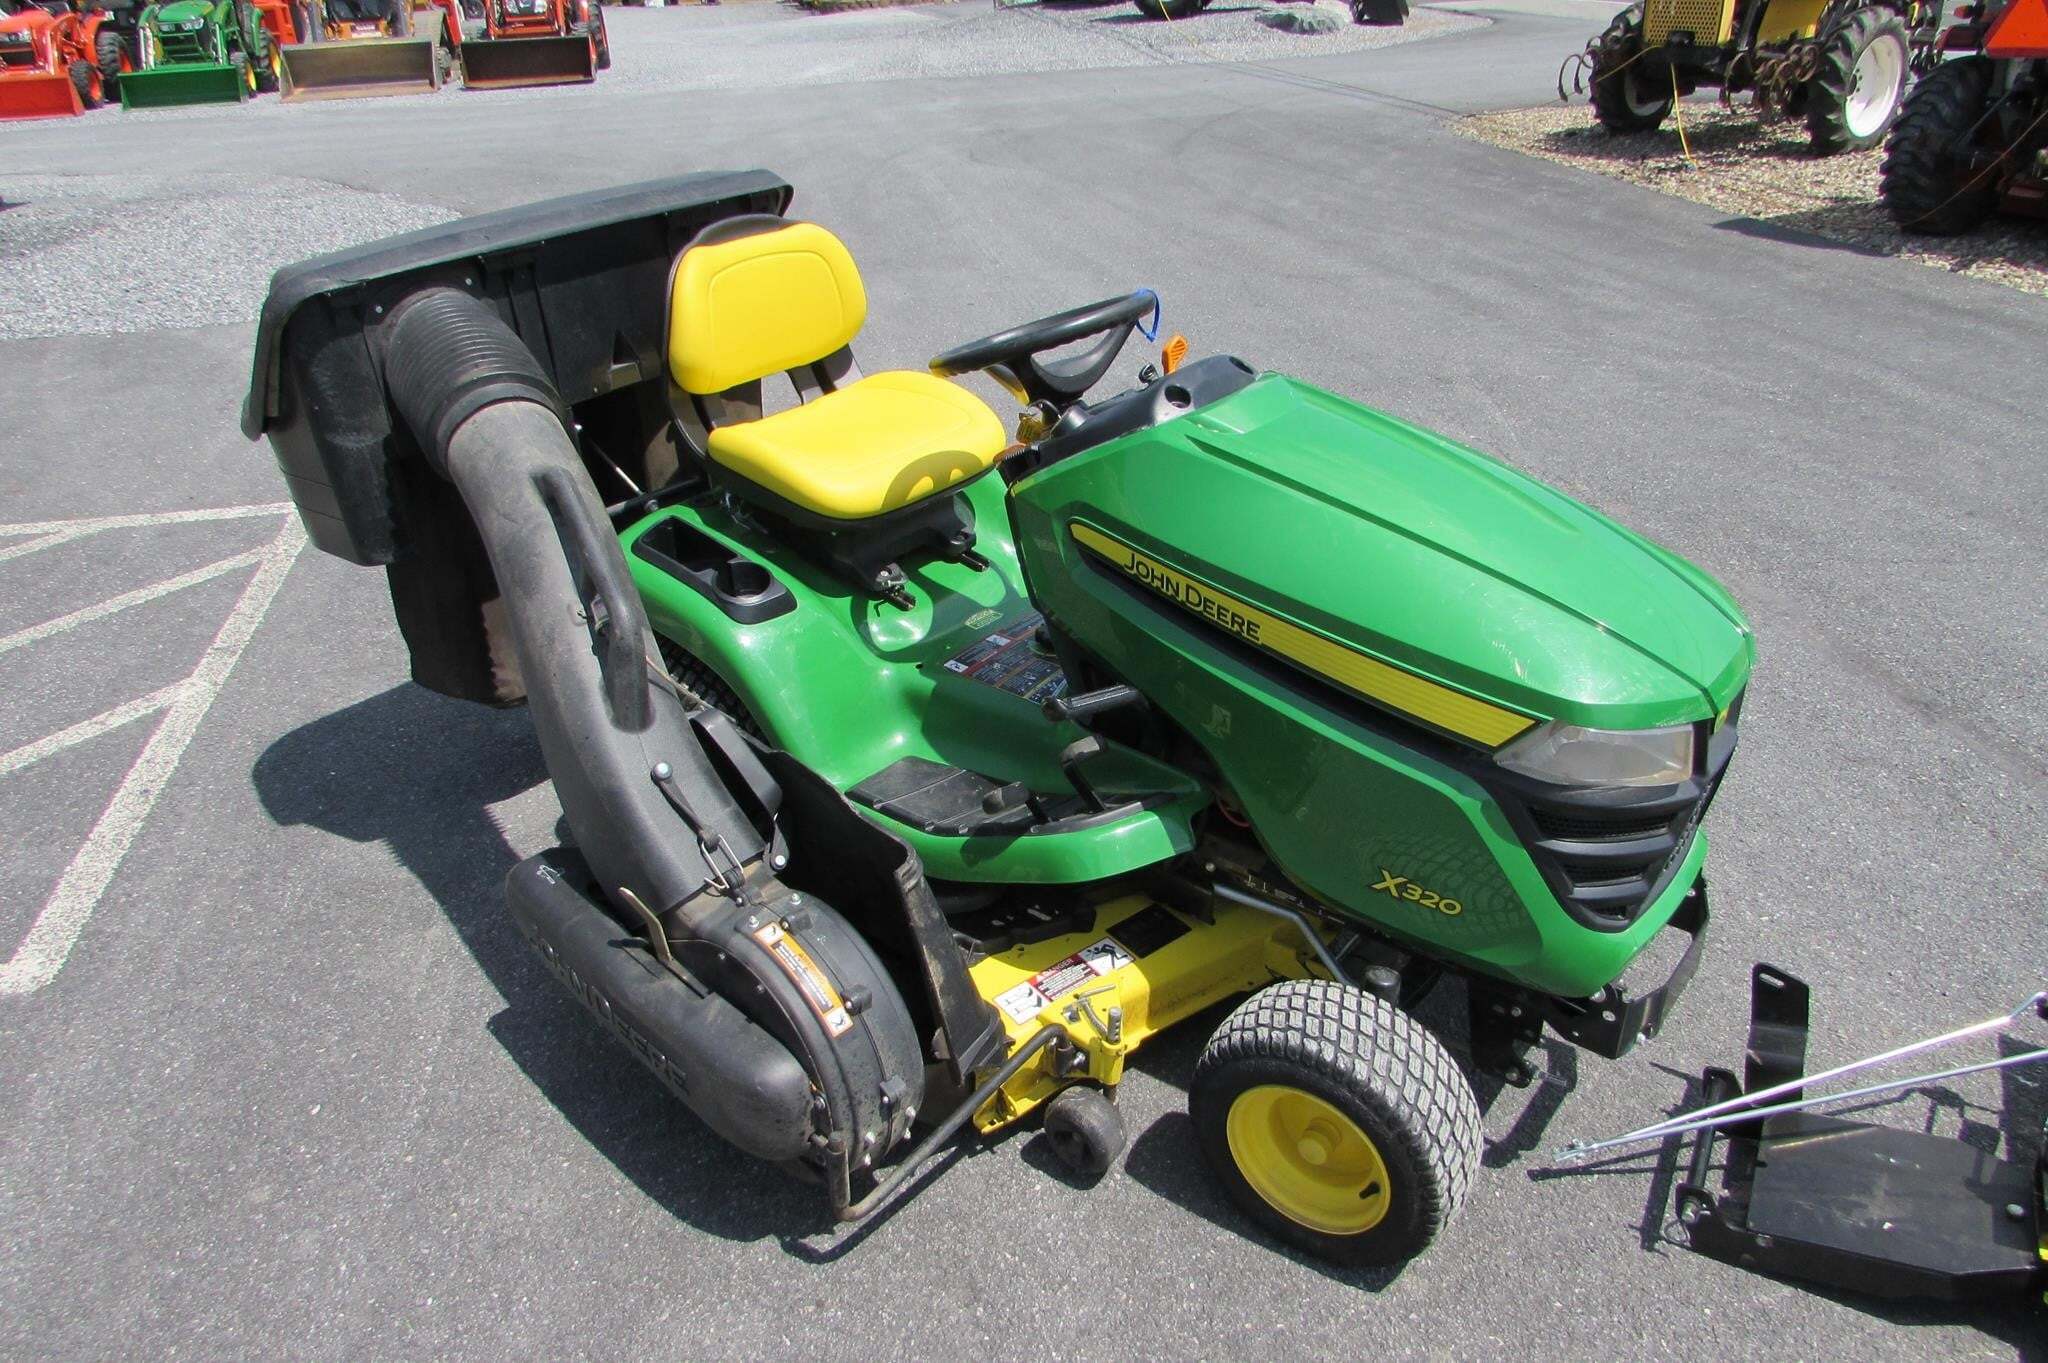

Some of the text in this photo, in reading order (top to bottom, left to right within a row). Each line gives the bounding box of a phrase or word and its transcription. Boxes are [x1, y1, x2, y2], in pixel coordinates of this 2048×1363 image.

[1123, 552, 1261, 642] JOHN DEERE
[1371, 868, 1462, 915] X320
